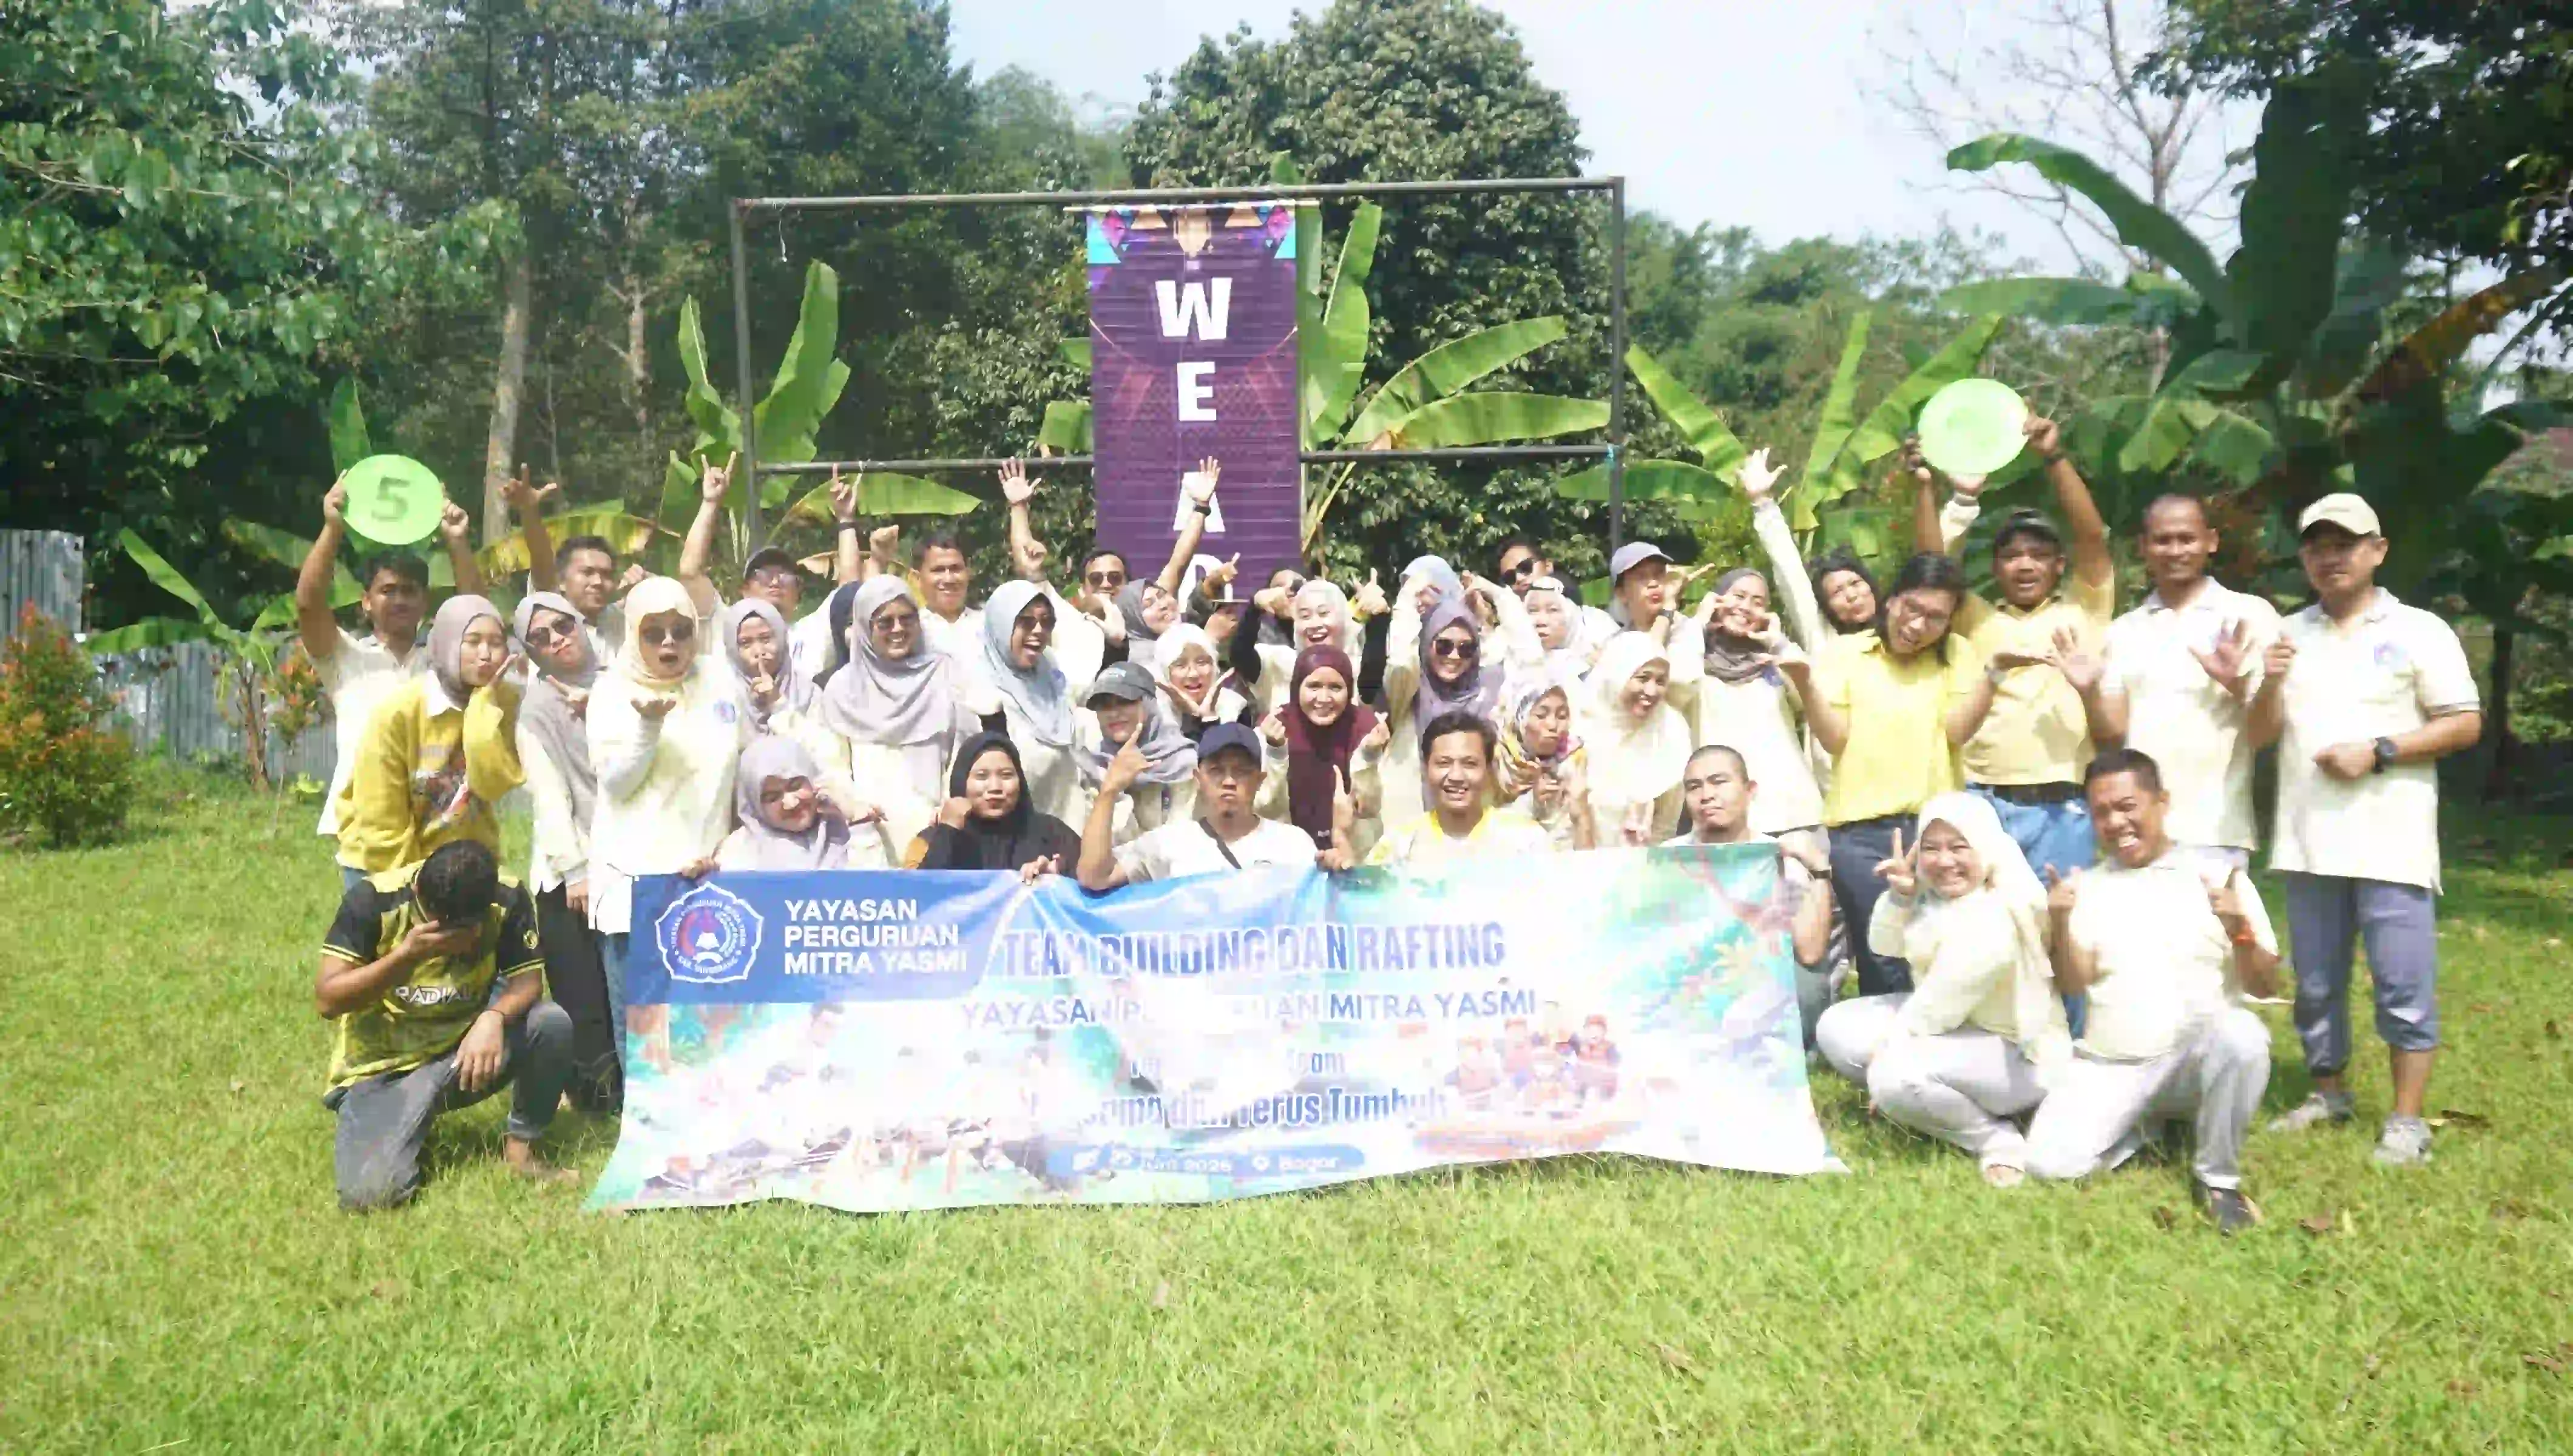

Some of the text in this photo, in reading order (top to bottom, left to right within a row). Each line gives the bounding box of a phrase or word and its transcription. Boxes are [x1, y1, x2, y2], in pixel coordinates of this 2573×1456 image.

[1155, 277, 1233, 421] WE
[371, 475, 411, 522] 5
[785, 898, 917, 922] YAYASAN
[785, 923, 959, 948] PERGURUAN
[1002, 920, 1506, 976] TEAM BUILDING DAN RAFTING
[785, 949, 967, 974] MITRA YASMI
[962, 997, 1112, 1029] YAYASAN
[1330, 993, 1426, 1020] MITRA
[1433, 989, 1536, 1019] YASMI
